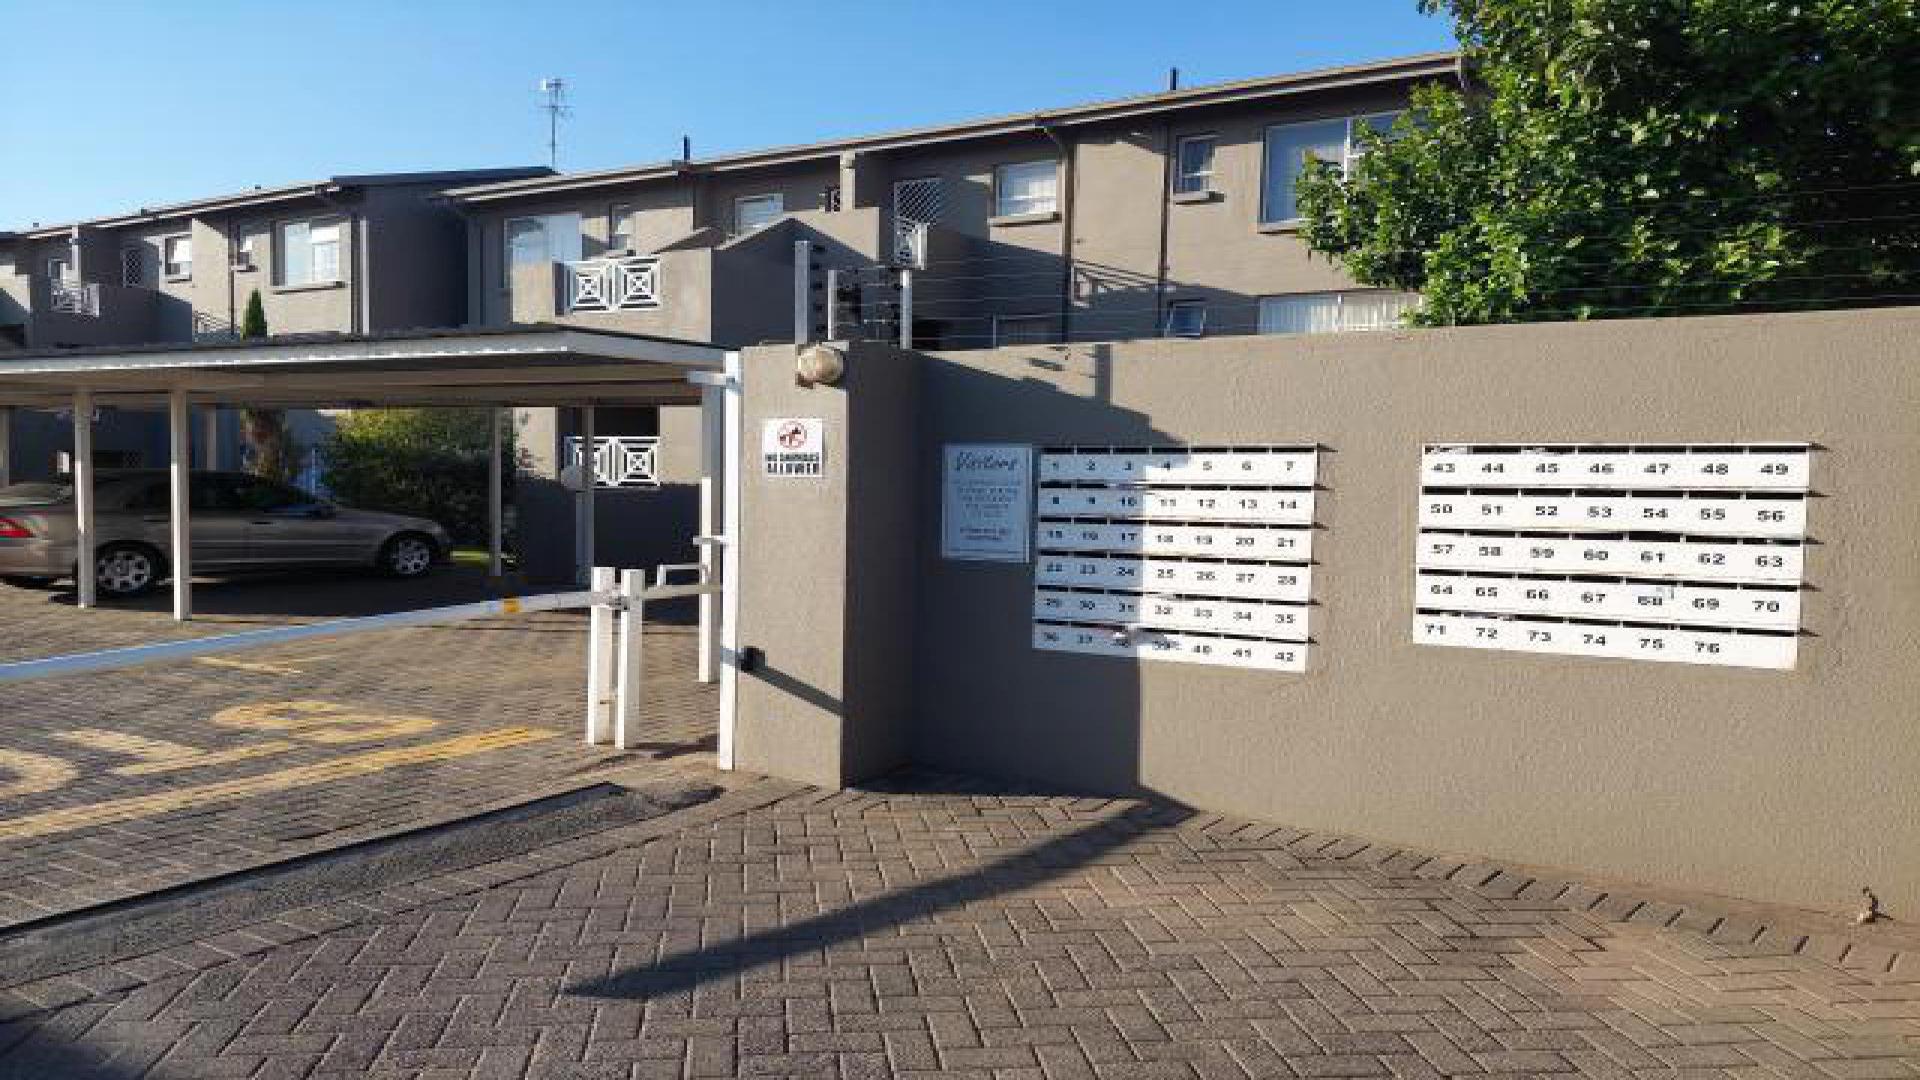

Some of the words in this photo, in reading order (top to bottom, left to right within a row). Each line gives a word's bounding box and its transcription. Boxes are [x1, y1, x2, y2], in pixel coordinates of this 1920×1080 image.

[1086, 459, 1096, 471] 2
[1123, 460, 1132, 471] 3
[1160, 460, 1173, 471] 4
[1202, 460, 1213, 472] 5
[1241, 460, 1252, 471] 6
[1286, 460, 1296, 471] 7
[1430, 462, 1456, 474] 43
[1481, 462, 1504, 474] 44
[1535, 462, 1561, 474] 45
[1589, 462, 1615, 474] 46
[1643, 462, 1672, 475] 47
[1700, 463, 1729, 476] 48
[1760, 463, 1789, 476] 49
[1118, 496, 1138, 507] 10
[1158, 498, 1177, 507] 11
[1197, 498, 1216, 509] 12
[1238, 498, 1258, 510] 13
[1277, 499, 1297, 510] 14
[1430, 503, 1453, 514] 50
[1481, 503, 1504, 516] 51
[1535, 505, 1558, 516] 52
[1586, 505, 1613, 519] 53
[1643, 507, 1669, 519] 54
[1700, 507, 1726, 521] 55
[1757, 510, 1786, 523] 56
[1046, 529, 1063, 539] 15
[1121, 532, 1138, 543] 17
[1156, 534, 1174, 543] 18
[1193, 535, 1213, 546] 19
[1235, 536, 1255, 547] 20
[1277, 537, 1294, 548] 21
[1431, 543, 1456, 555] 57
[1478, 546, 1501, 557] 58
[1529, 546, 1555, 559] 59
[1583, 548, 1609, 561] 60
[1640, 550, 1666, 563] 61
[1697, 553, 1726, 566] 62
[1754, 555, 1783, 568] 63
[1115, 566, 1135, 577] 24
[1157, 568, 1174, 579] 25
[1195, 570, 1216, 582] 26
[1235, 572, 1255, 584] 27
[1277, 575, 1297, 586] 28
[1430, 584, 1453, 595] 64
[1475, 586, 1498, 598] 65
[1526, 589, 1549, 601] 66
[1580, 591, 1606, 604] 67
[1637, 595, 1663, 607] 68
[1691, 597, 1720, 611] 69
[1751, 600, 1780, 613] 70
[1079, 599, 1096, 611] 30
[1154, 604, 1174, 616] 32
[1232, 611, 1252, 622] 34
[1274, 613, 1297, 624] 35
[1424, 623, 1447, 636] 71
[1475, 627, 1498, 640] 72
[1529, 629, 1552, 642] 73
[1583, 633, 1606, 647] 74
[1640, 638, 1663, 649] 75
[1694, 640, 1720, 654] 76
[1232, 647, 1252, 658] 41
[1274, 651, 1294, 663] 42
